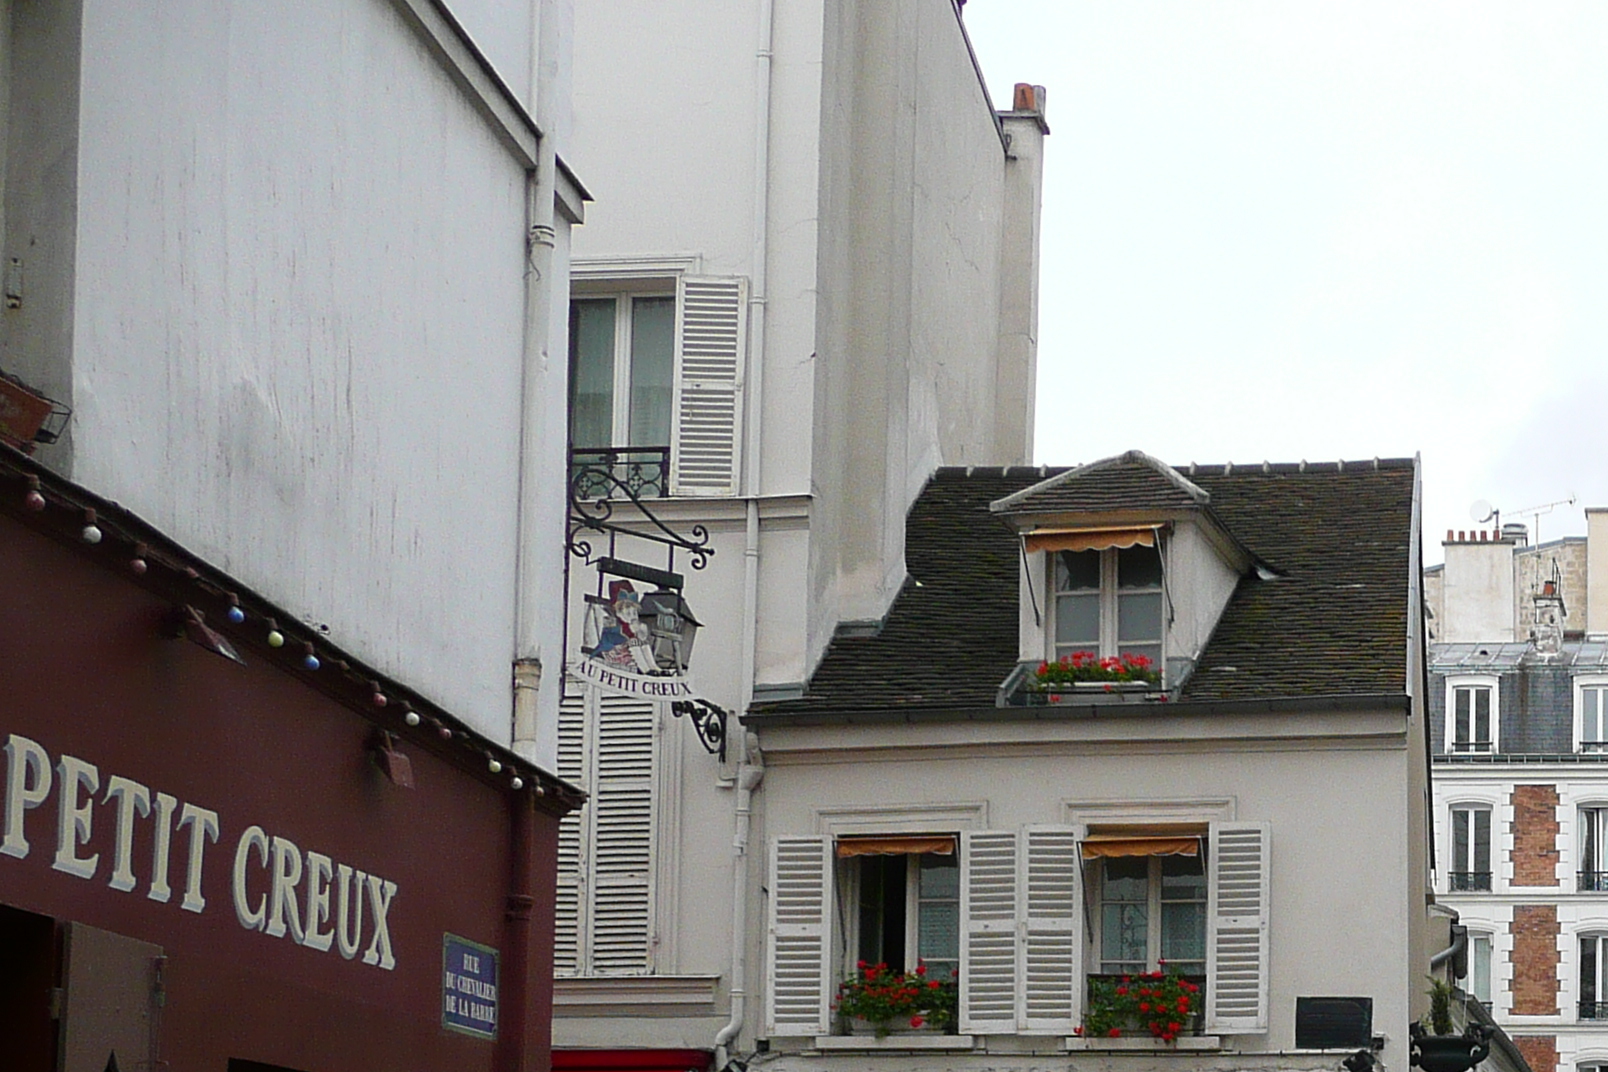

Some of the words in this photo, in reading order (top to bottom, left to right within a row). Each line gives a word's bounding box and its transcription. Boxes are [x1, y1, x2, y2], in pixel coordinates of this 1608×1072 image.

[575, 661, 598, 678] AU
[599, 669, 639, 693] PETIT
[642, 681, 693, 696] CREUX
[0, 733, 220, 913] PETIT
[233, 825, 398, 970] CREUX
[463, 953, 480, 974] RUE
[446, 971, 456, 989] DU
[457, 975, 496, 1001] CHEVALIER
[446, 994, 457, 1013] DE
[459, 998, 469, 1017] LA
[471, 1002, 496, 1023] BARRE
